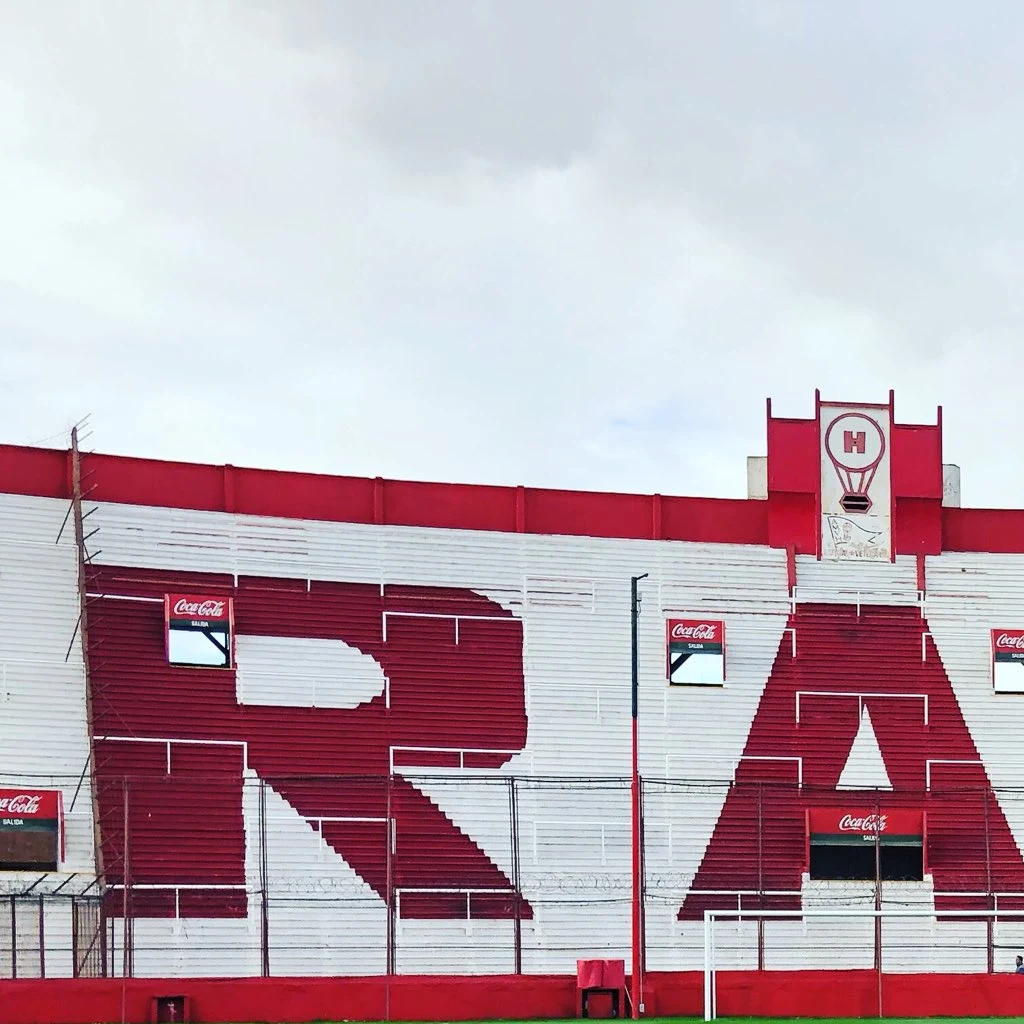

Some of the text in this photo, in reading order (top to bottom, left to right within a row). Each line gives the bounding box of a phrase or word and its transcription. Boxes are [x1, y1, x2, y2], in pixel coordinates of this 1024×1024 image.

[843, 430, 866, 454] H
[173, 598, 226, 617] Coca-Cola
[671, 623, 717, 639] Coca-Cola
[2, 818, 24, 826] SALIDA
